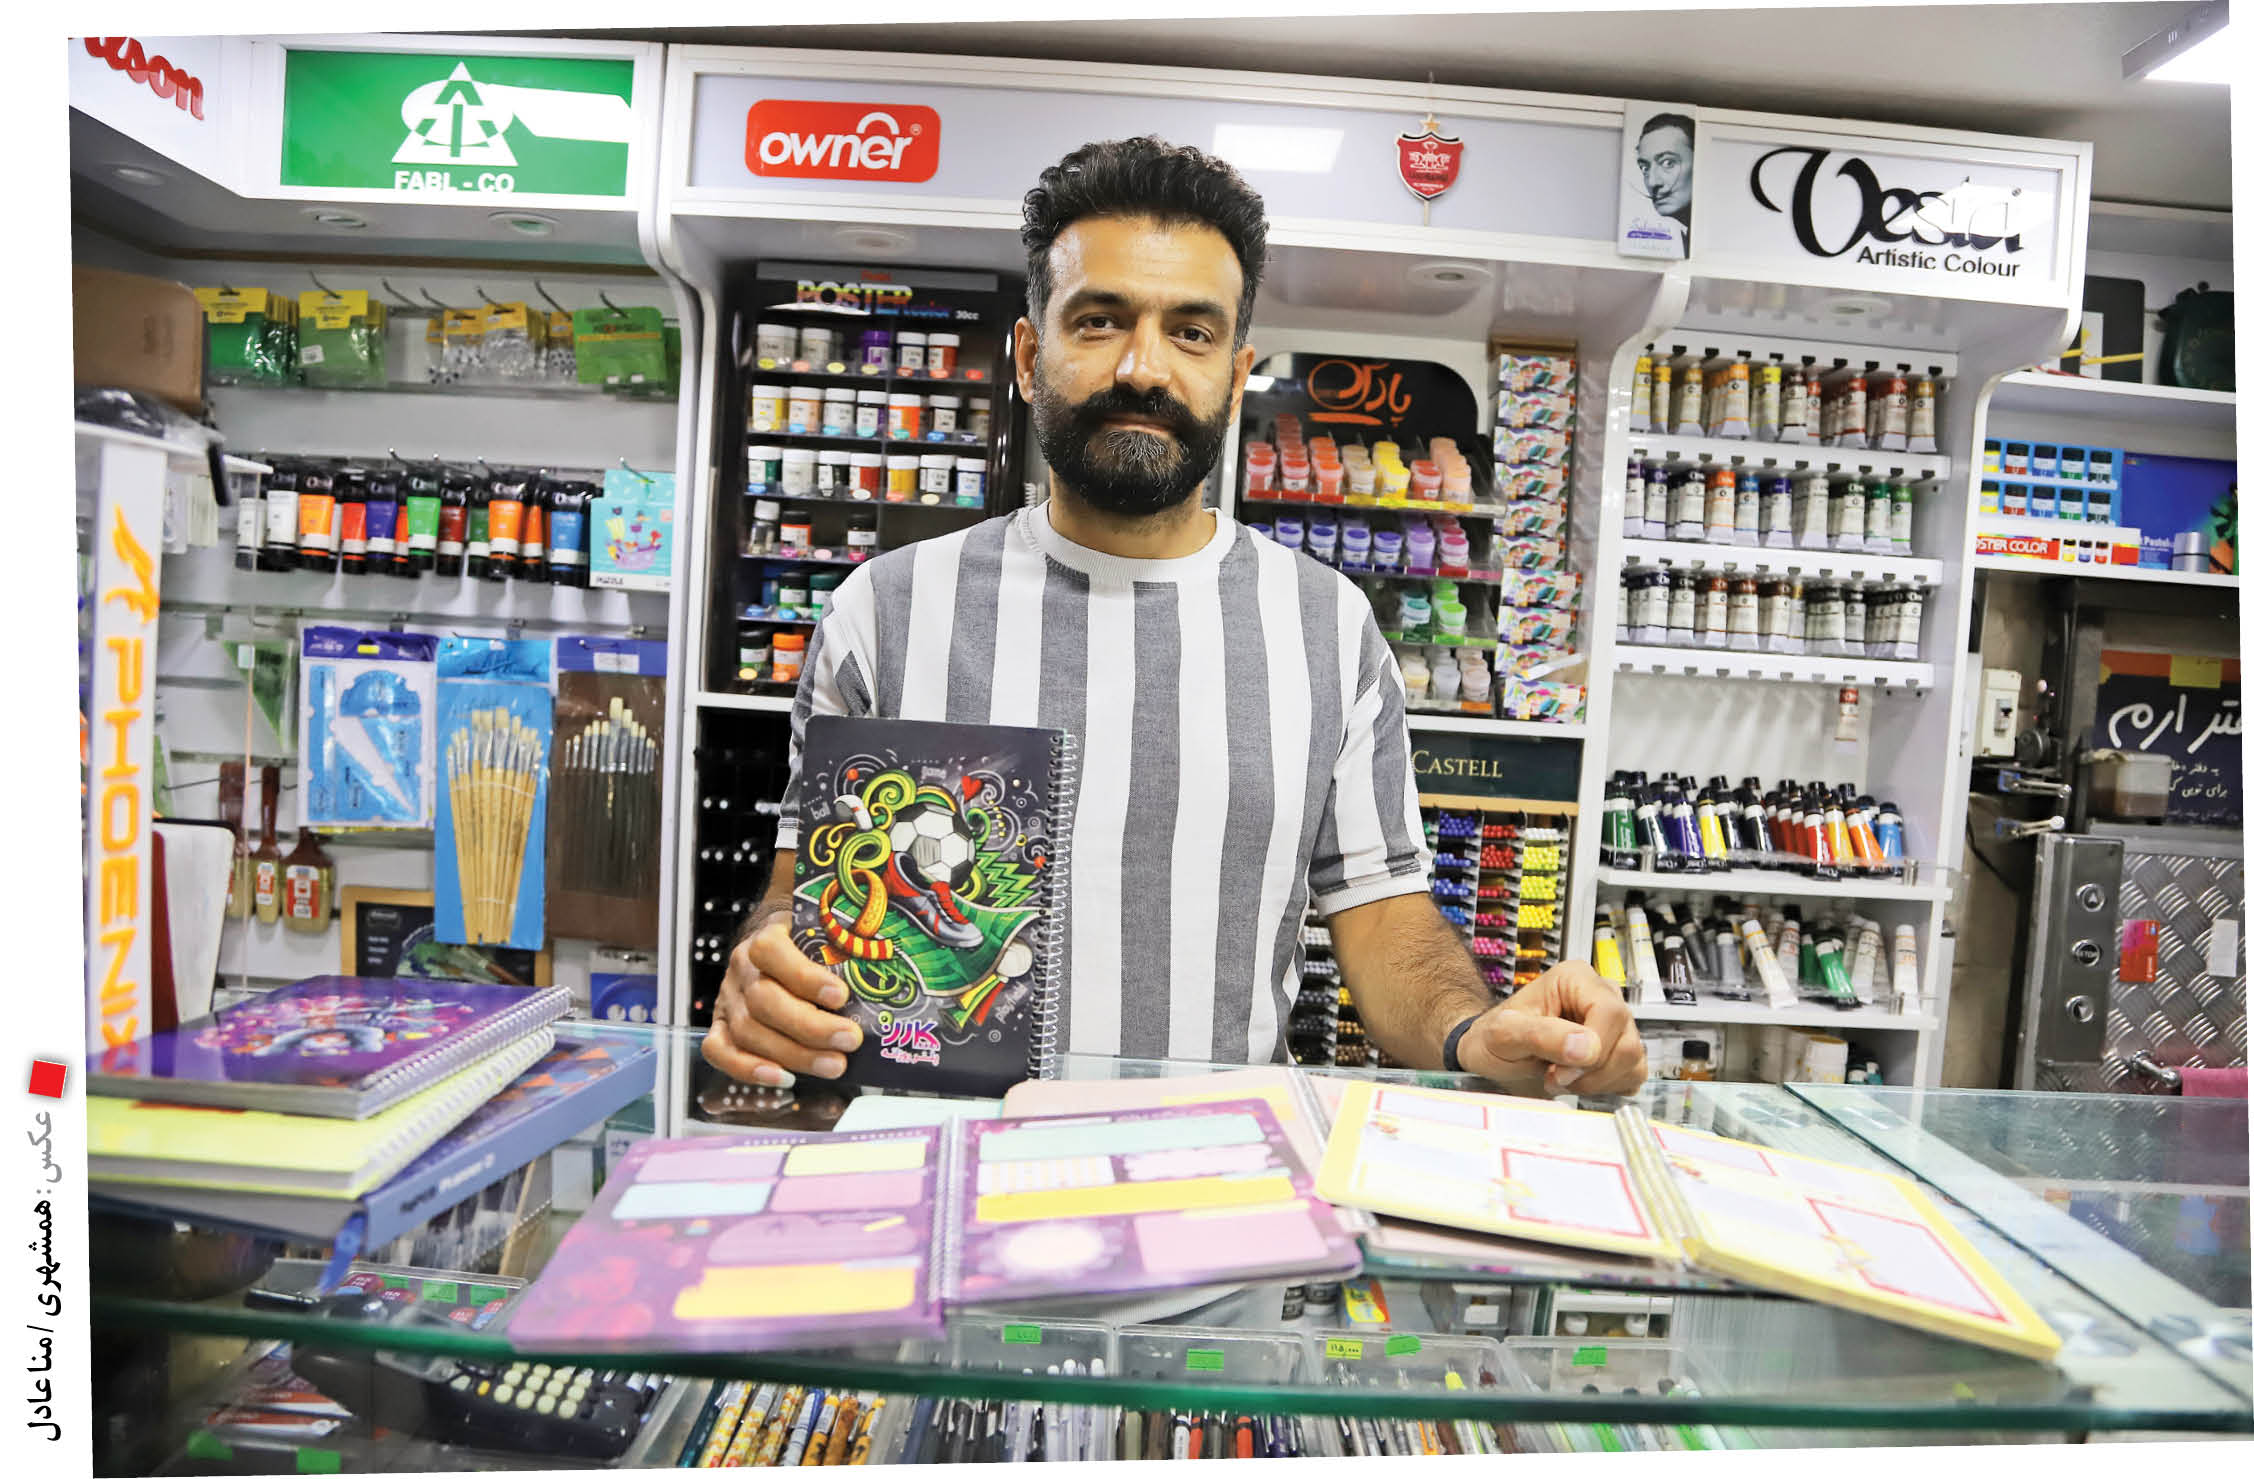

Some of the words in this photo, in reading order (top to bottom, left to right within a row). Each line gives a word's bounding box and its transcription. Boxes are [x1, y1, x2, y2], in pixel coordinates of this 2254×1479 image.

[760, 126, 912, 170] owner
[1856, 245, 1937, 271] Artistic
[1944, 253, 2021, 278] Colour
[2010, 540, 2049, 554] COLOR
[1411, 749, 1503, 778] CASTELL
